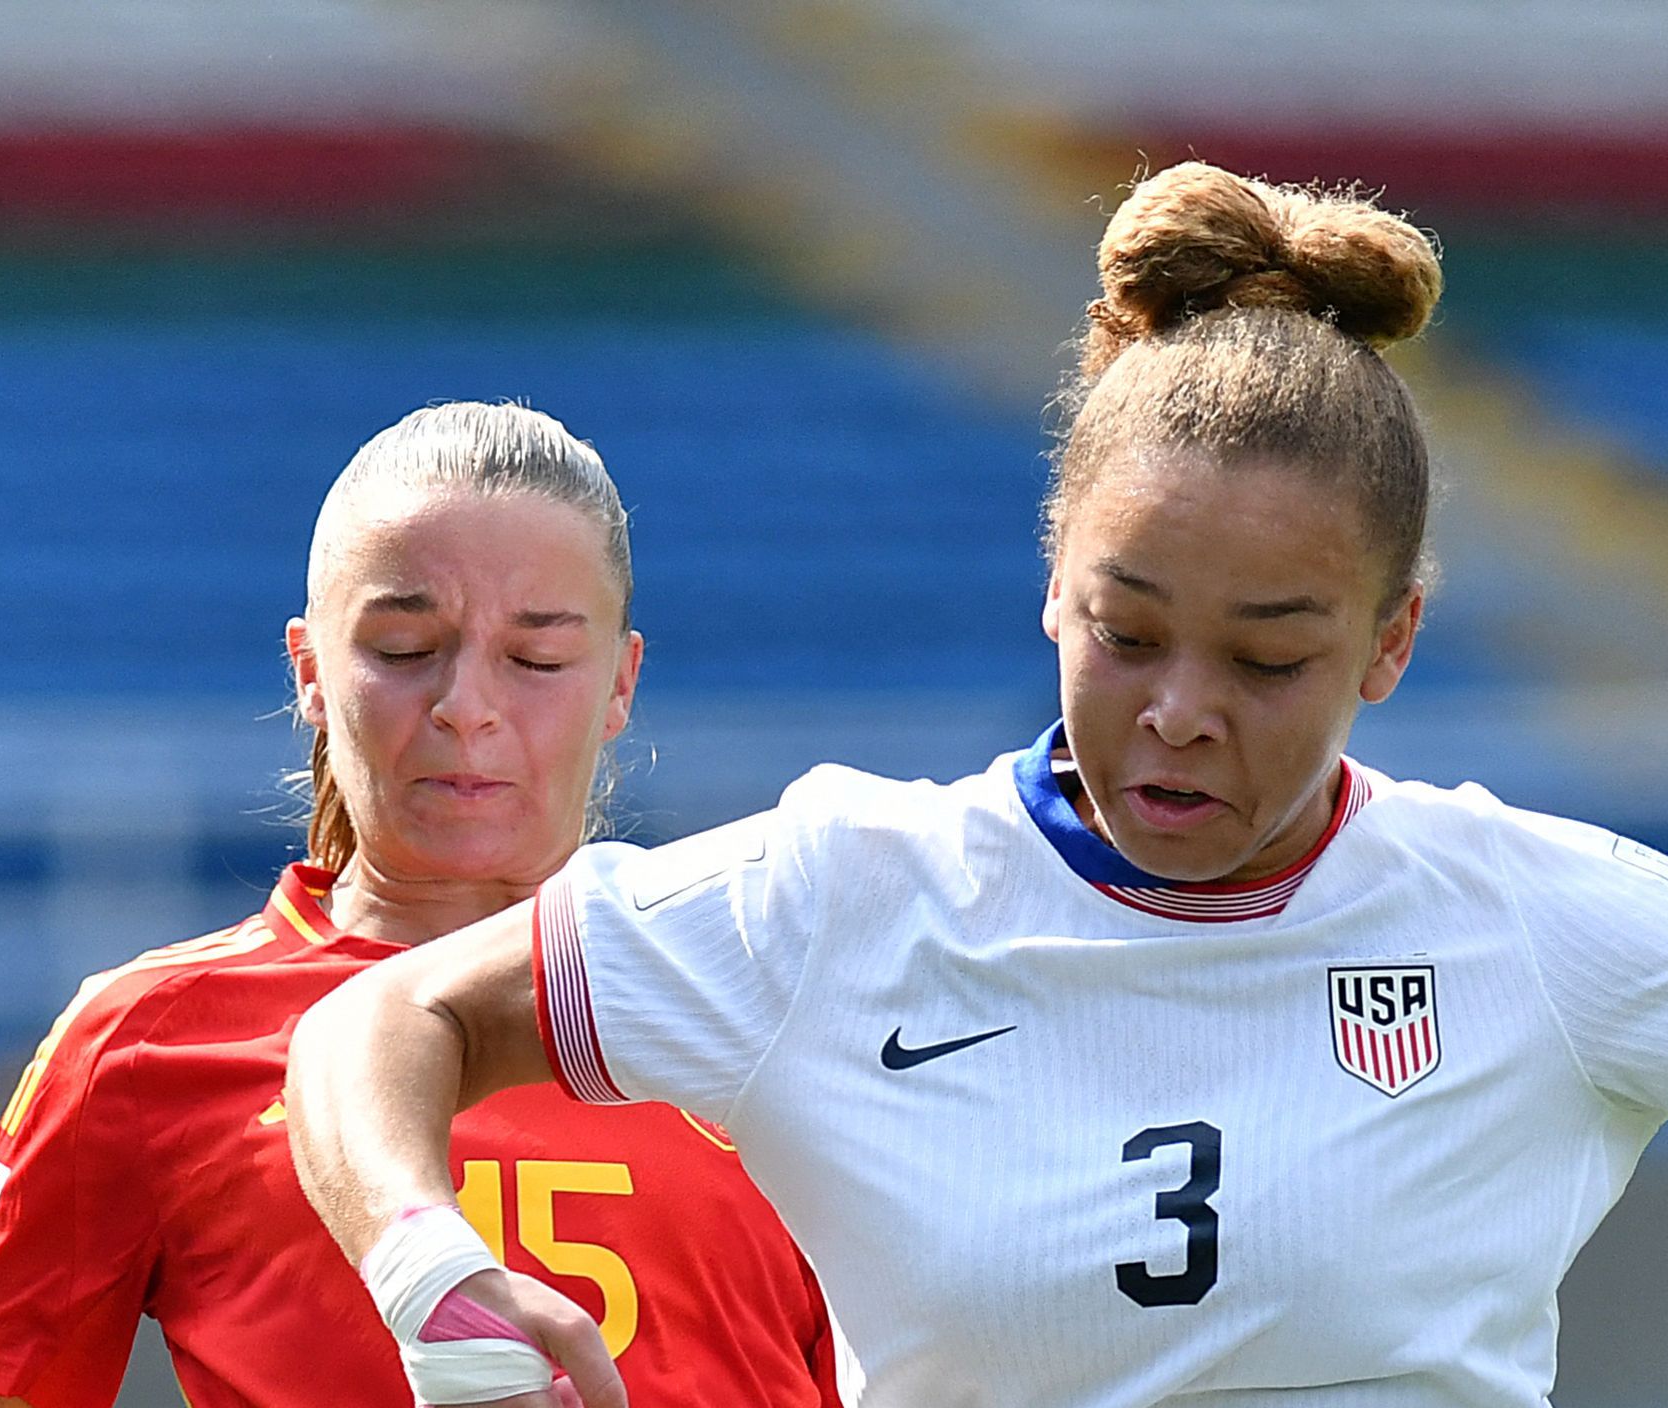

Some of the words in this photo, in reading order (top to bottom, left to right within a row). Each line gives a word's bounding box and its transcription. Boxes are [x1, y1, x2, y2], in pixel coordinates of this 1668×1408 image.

[1337, 975, 1428, 1027] USA
[455, 1159, 639, 1361] 15
[1114, 1120, 1223, 1308] 3
